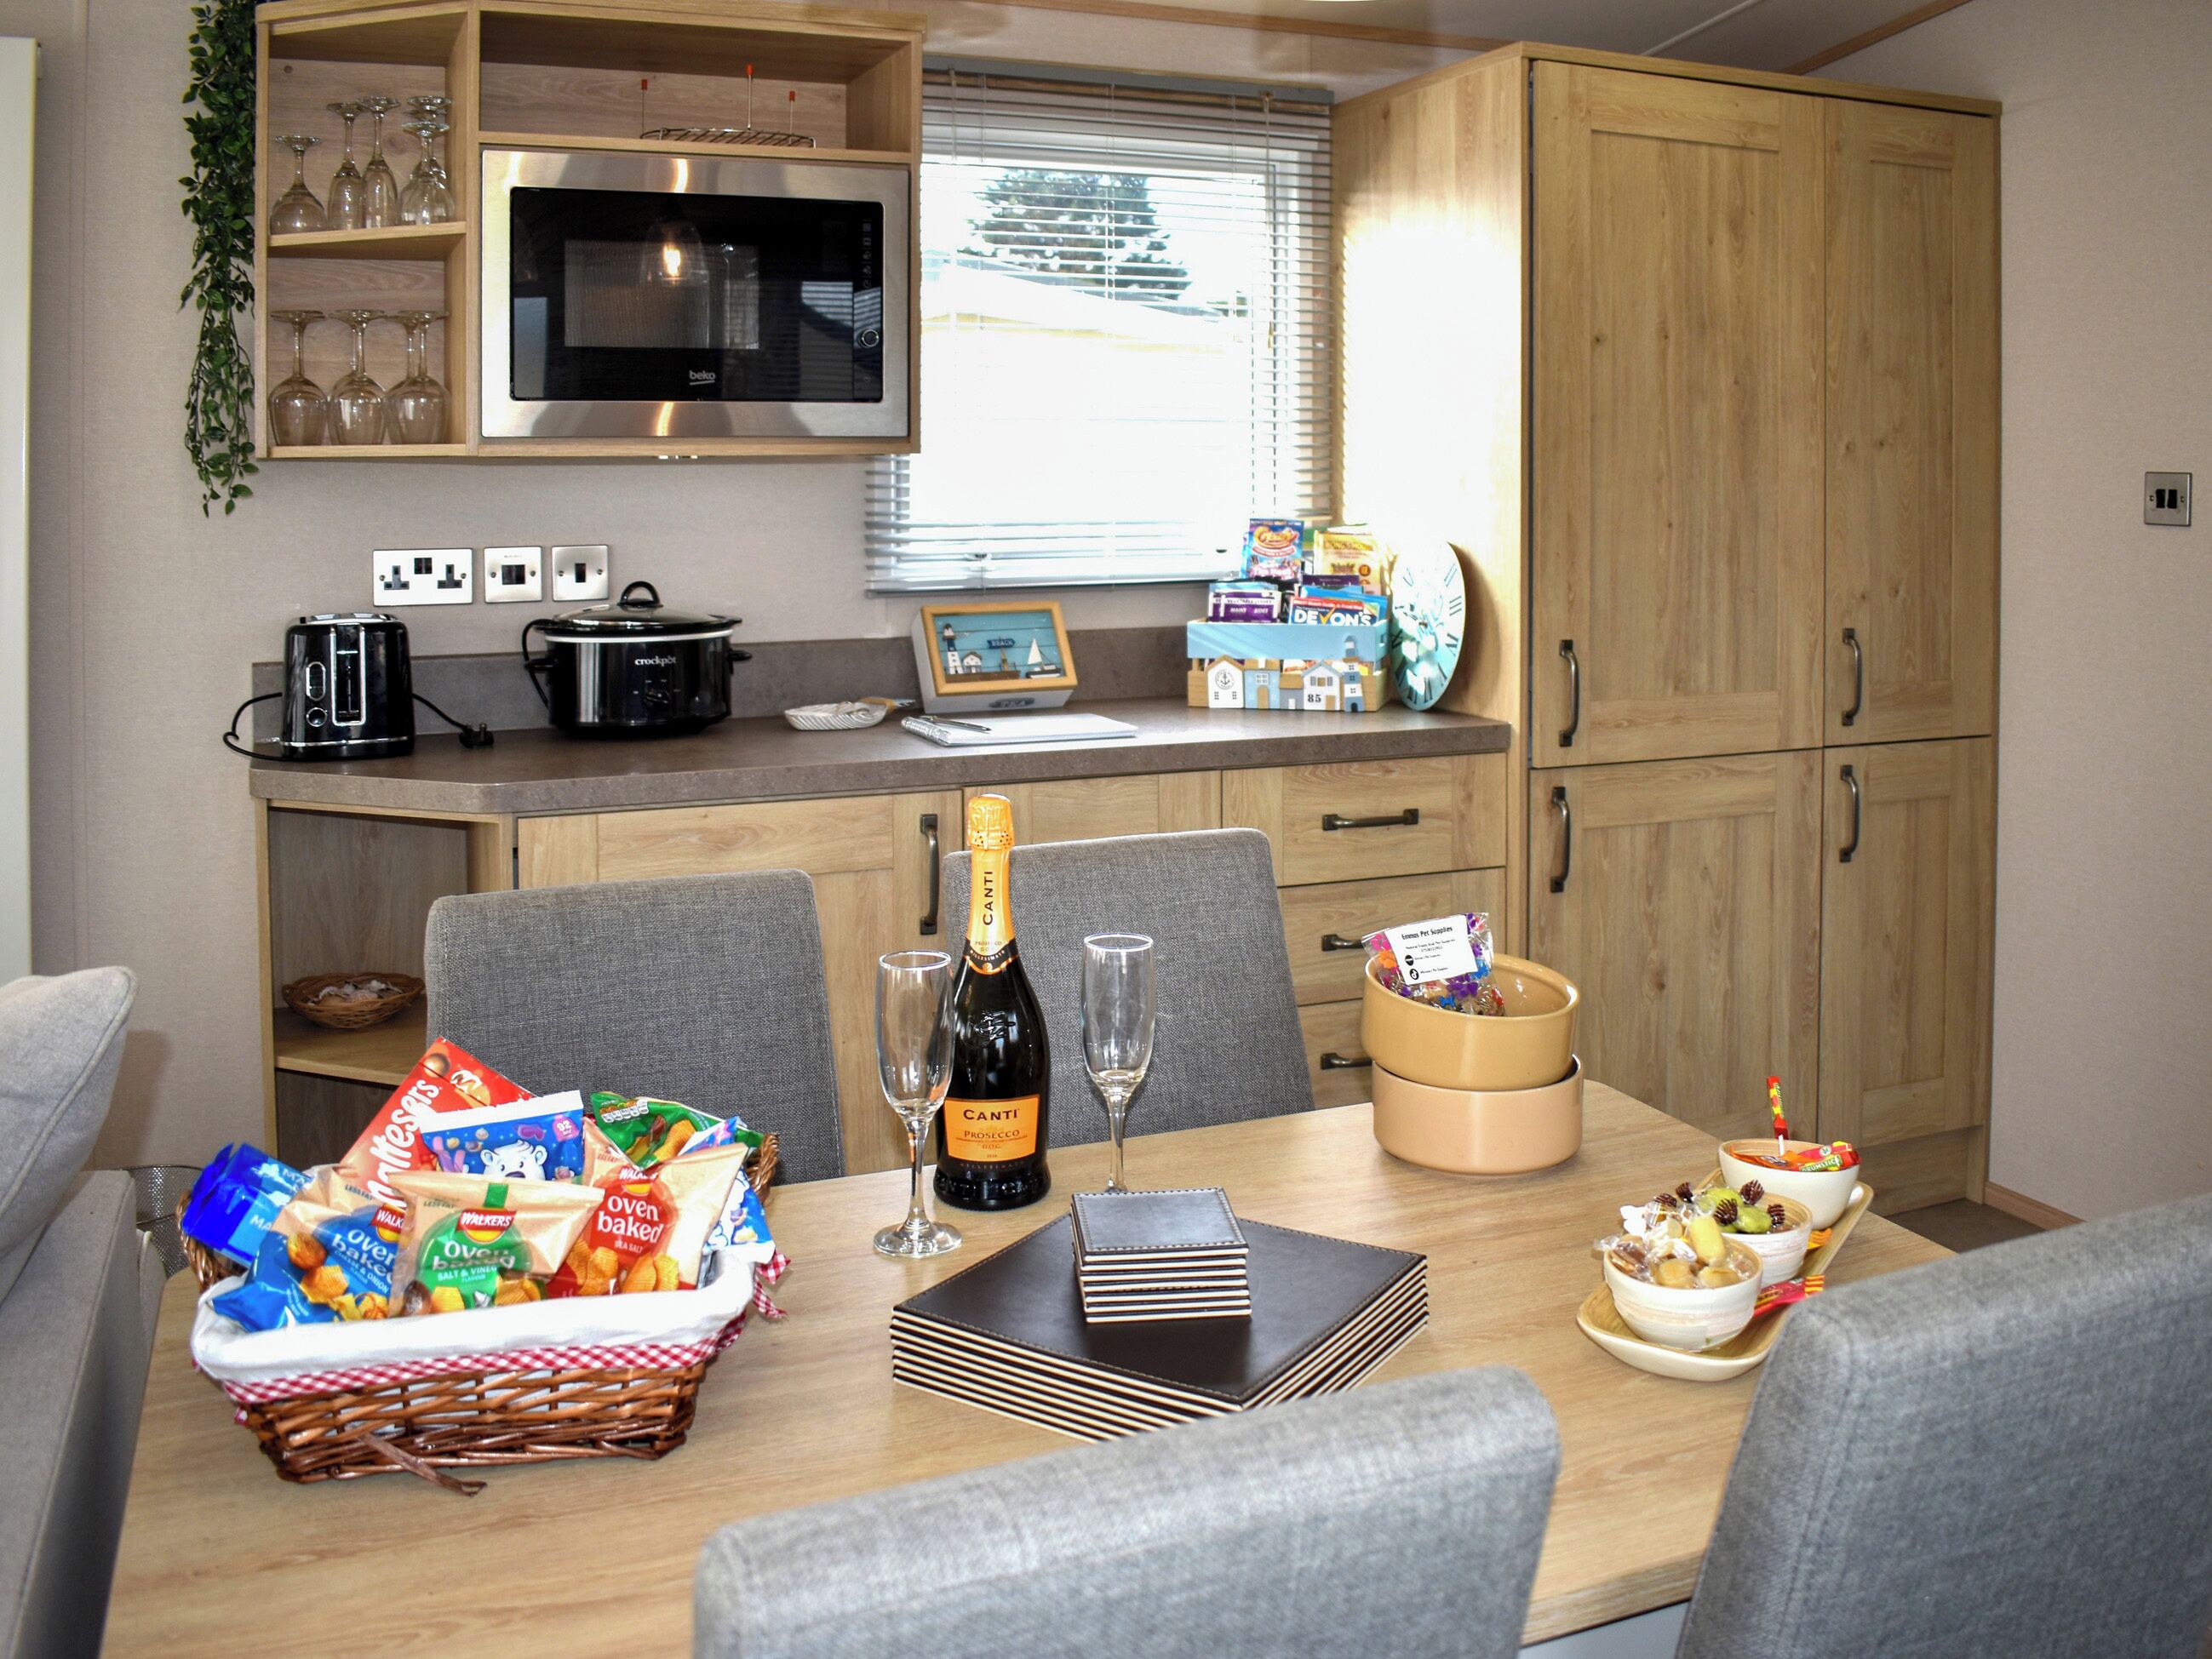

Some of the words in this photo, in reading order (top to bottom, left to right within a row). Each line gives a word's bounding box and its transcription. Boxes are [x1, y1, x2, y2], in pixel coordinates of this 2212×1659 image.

[689, 369, 716, 380] beko
[634, 655, 677, 667] crockpot
[1307, 694, 1322, 703] 85
[983, 871, 994, 925] CANTI
[1430, 926, 1453, 935] Supplies
[963, 1109, 1018, 1120] CANTI
[556, 1119, 572, 1132] 92
[964, 1130, 1020, 1139] PROSECCO
[619, 1168, 659, 1180] WALKS
[607, 1195, 660, 1221] oven
[376, 1210, 404, 1227] WALK
[461, 1212, 513, 1227] WALKERS
[597, 1210, 664, 1243] baked
[628, 1243, 644, 1253] SALT
[438, 1269, 458, 1281] SALT
[461, 1268, 469, 1277] &
[367, 1272, 389, 1294] ONION
